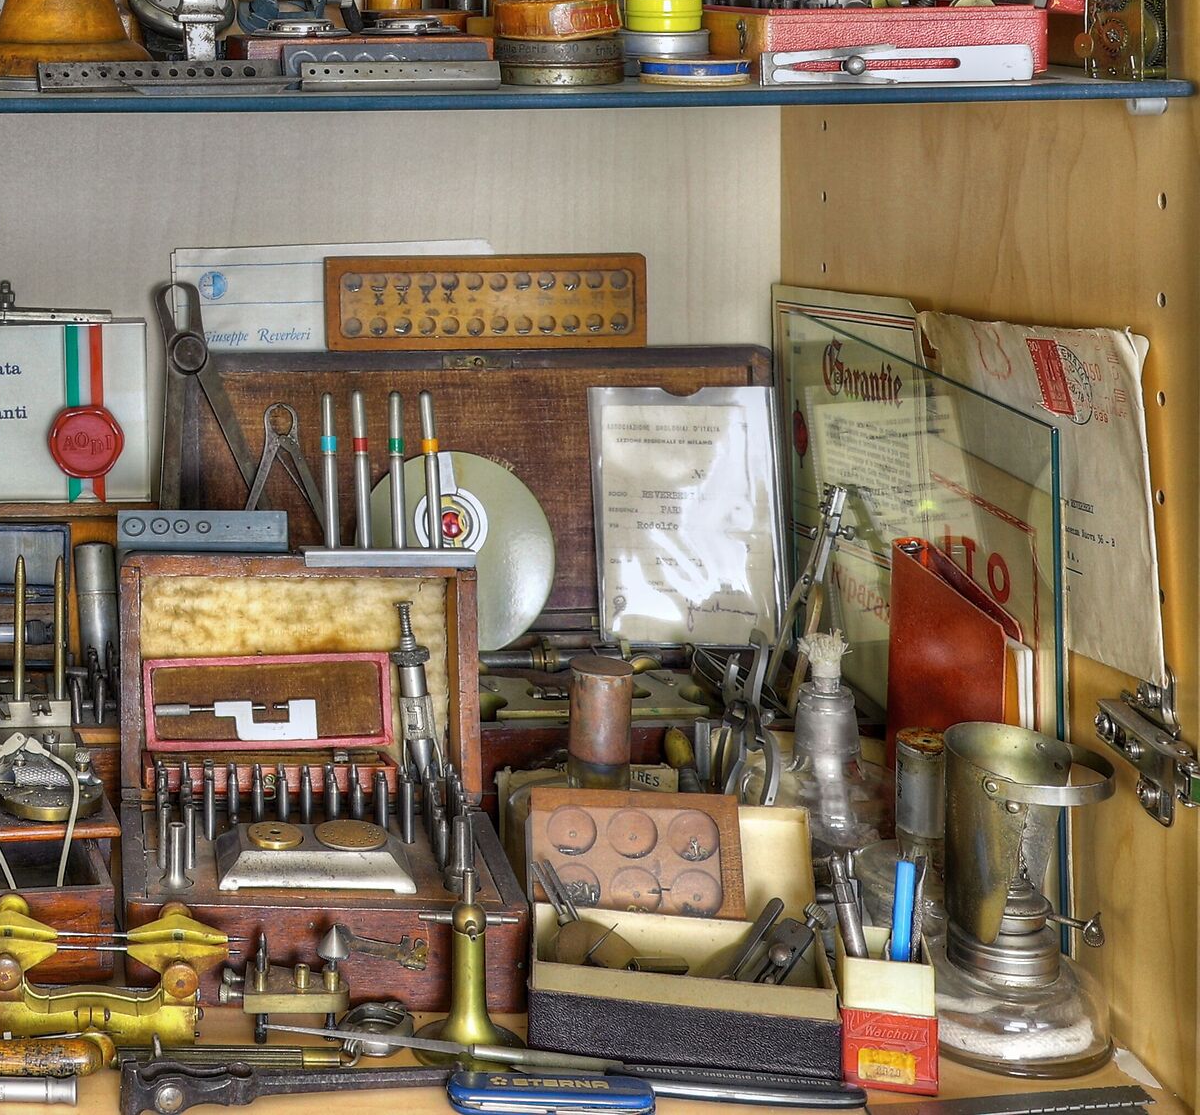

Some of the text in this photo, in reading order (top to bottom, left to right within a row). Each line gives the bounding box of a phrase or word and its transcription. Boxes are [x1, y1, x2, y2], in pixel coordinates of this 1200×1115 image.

[257, 327, 312, 344] Reverberi
[822, 336, 903, 410] Garantie
[636, 519, 679, 531] Rodolfo
[865, 1024, 919, 1041] Watchoil
[635, 1065, 696, 1078] BARRETT
[511, 1077, 610, 1090] ETERNA
